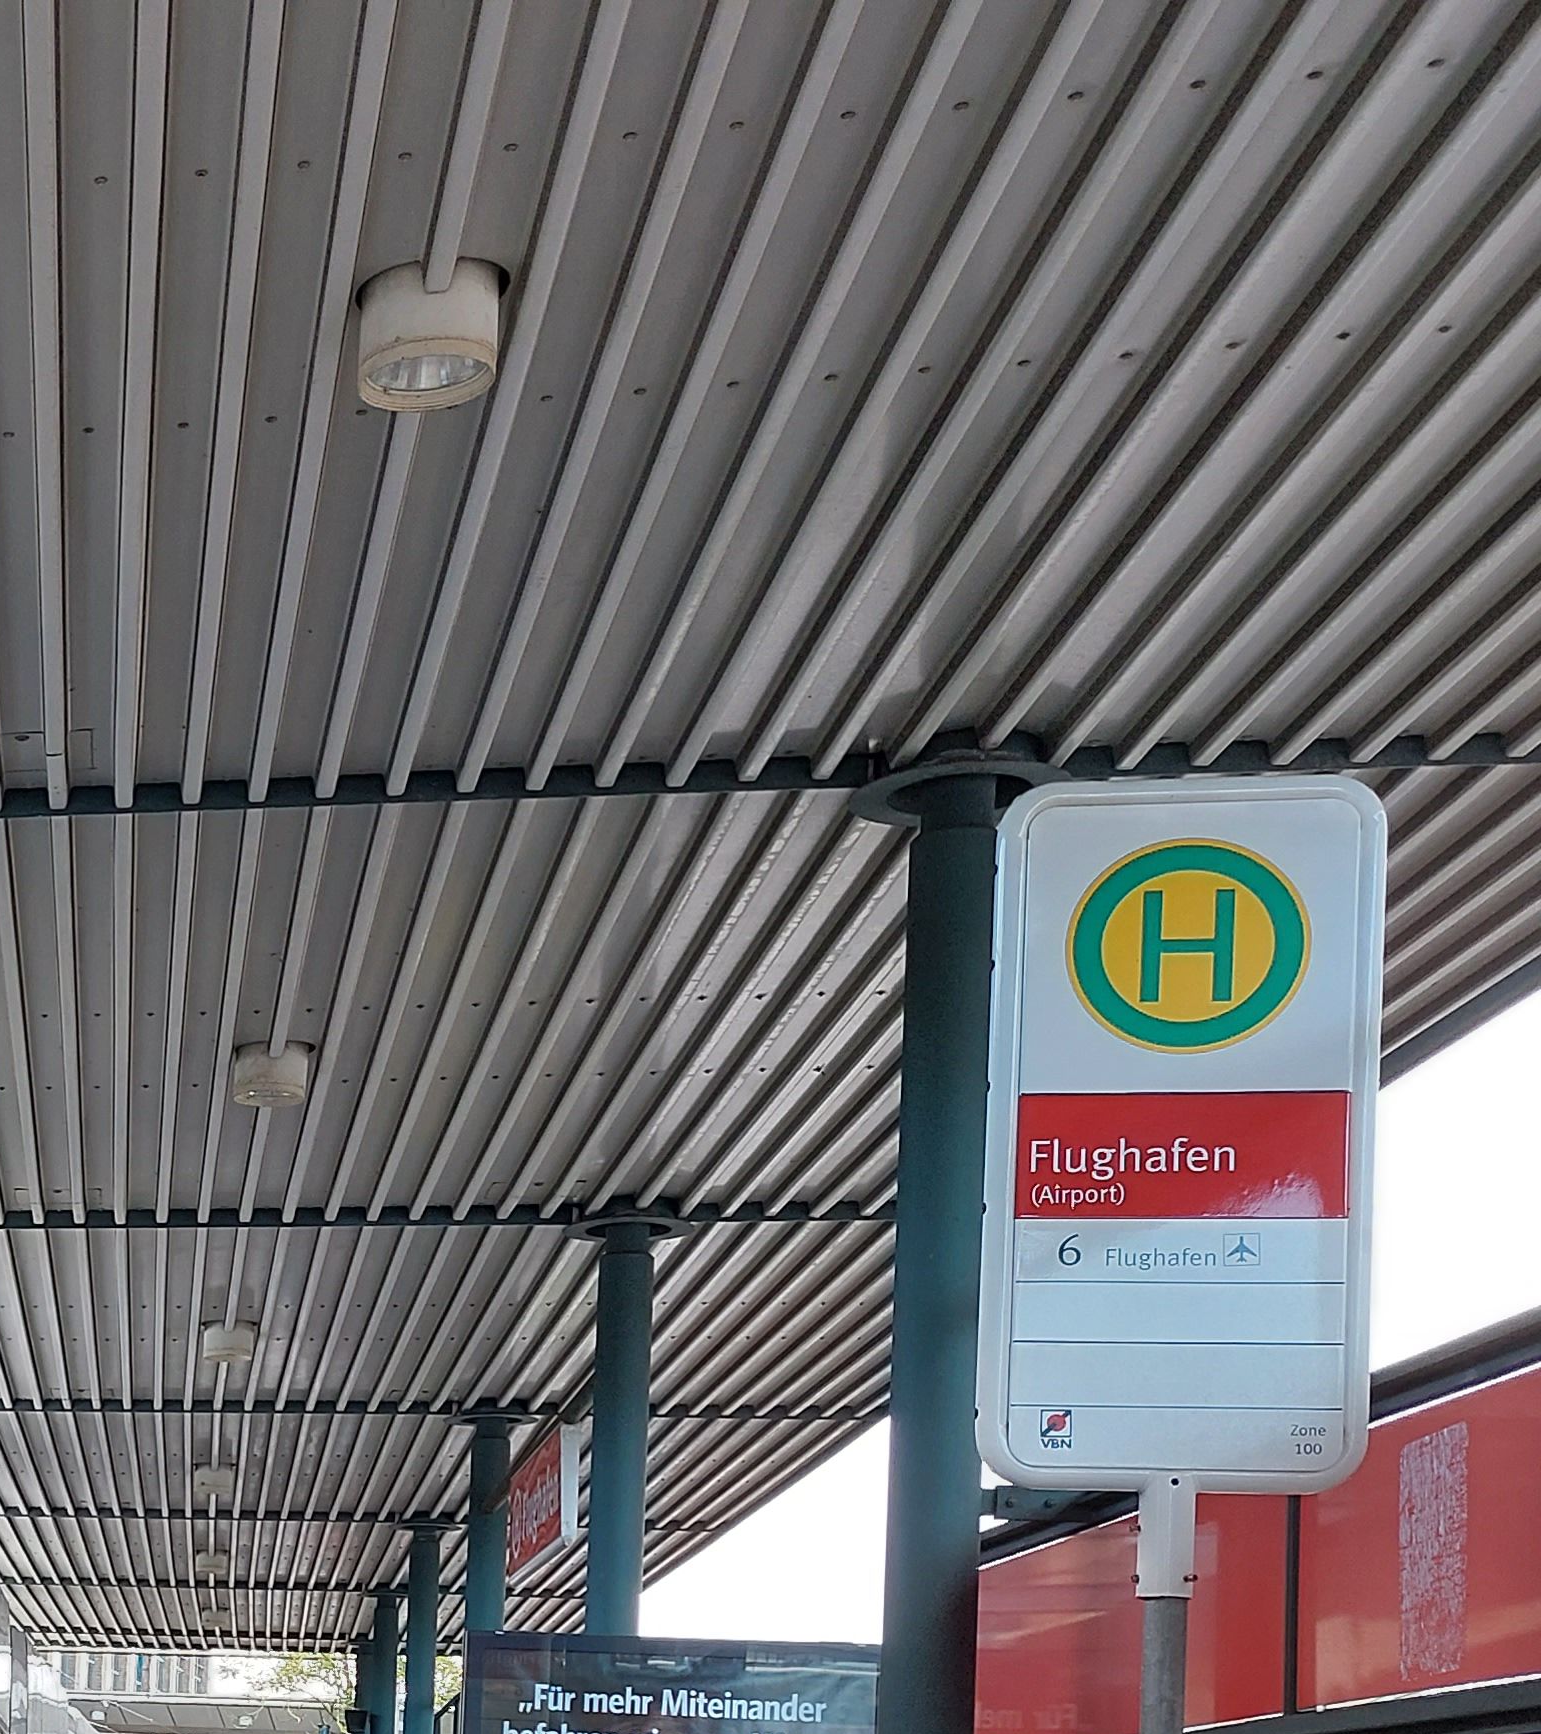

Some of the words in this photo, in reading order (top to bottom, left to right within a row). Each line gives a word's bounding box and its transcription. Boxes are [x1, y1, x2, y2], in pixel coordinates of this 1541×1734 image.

[1029, 1137, 1237, 1180] Flughafen
[1030, 1181, 1126, 1210] (Airport)
[1057, 1233, 1082, 1267] 6
[1104, 1244, 1218, 1270] Flughafen
[1040, 1436, 1073, 1450] VBN
[1289, 1423, 1327, 1438] Zone
[1294, 1442, 1323, 1456] 100
[517, 1682, 575, 1715] „Für
[582, 1686, 653, 1717] mehr
[660, 1687, 827, 1724] Miteinander
